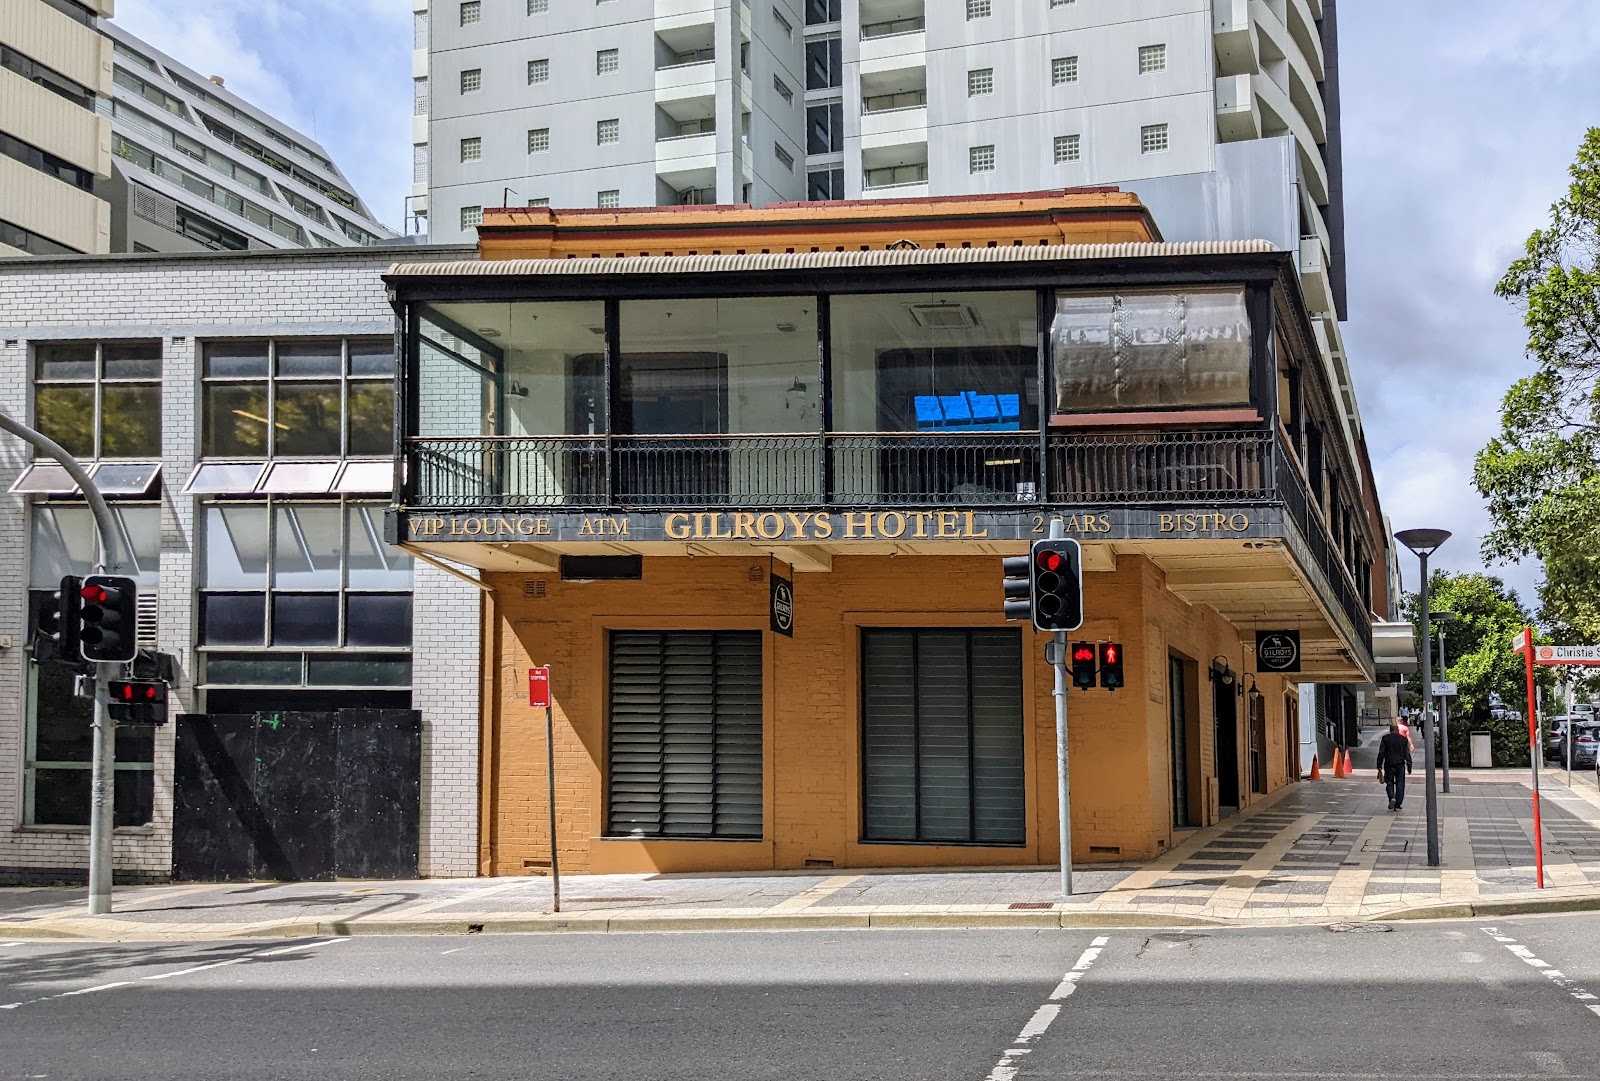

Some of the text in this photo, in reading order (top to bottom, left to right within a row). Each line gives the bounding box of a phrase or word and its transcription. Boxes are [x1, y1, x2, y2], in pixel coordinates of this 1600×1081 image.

[408, 517, 551, 535] VIP LOUNGE
[579, 518, 629, 535] ATM
[664, 511, 988, 539] GILROYS HOTEL
[1031, 515, 1044, 533] 2
[1158, 513, 1249, 532] BISTRO
[1557, 646, 1593, 658] Christie
